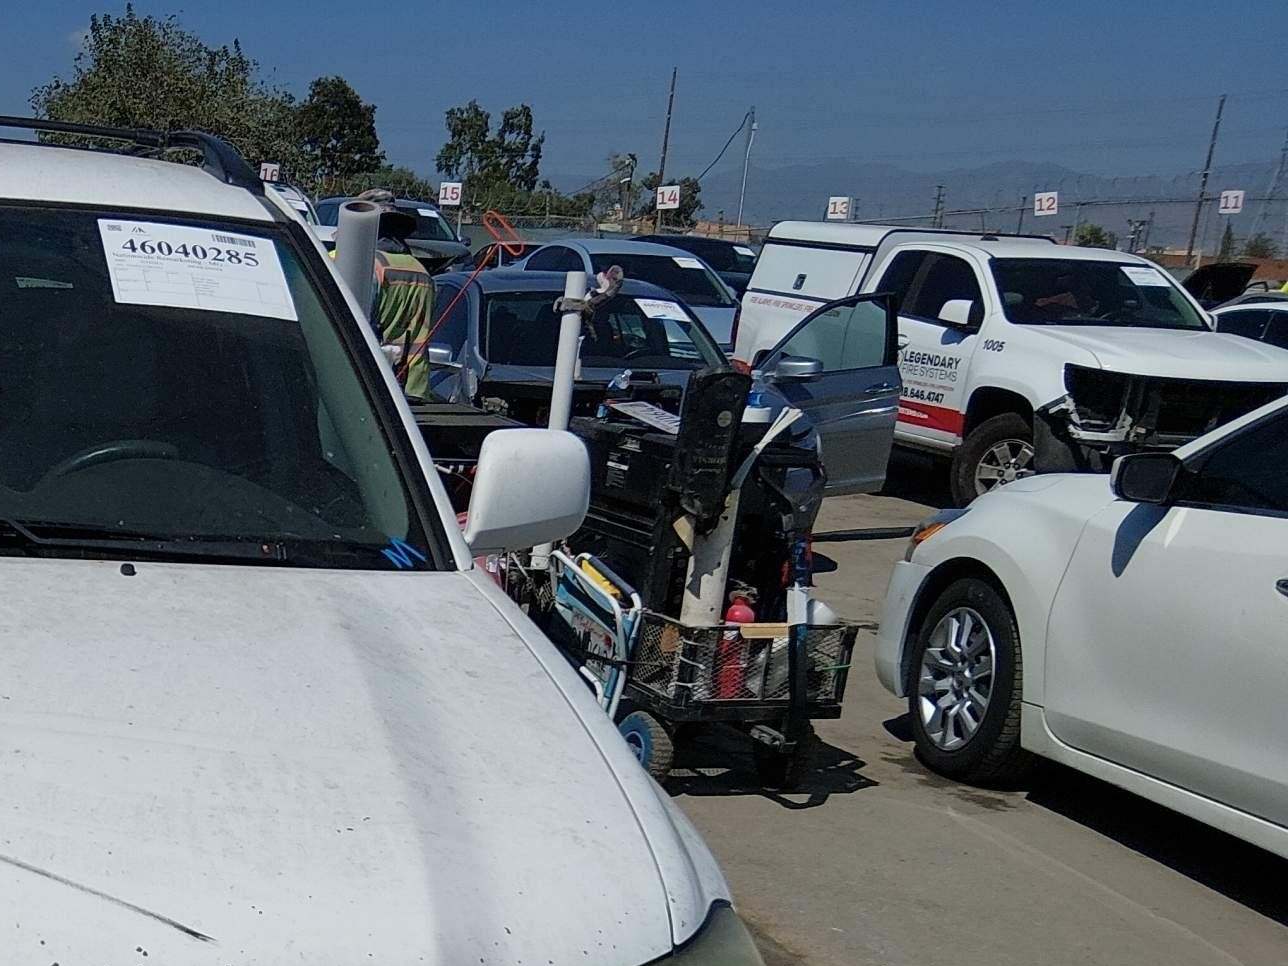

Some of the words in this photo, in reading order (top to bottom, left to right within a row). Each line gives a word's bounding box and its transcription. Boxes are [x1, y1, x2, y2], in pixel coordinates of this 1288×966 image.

[440, 186, 459, 203] 15
[658, 189, 677, 206] 14
[1221, 195, 1240, 210] 11
[830, 201, 848, 216] 13
[1036, 197, 1055, 212] 12
[122, 238, 259, 267] 46040285
[983, 338, 1006, 353] 1005
[903, 350, 962, 371] LEGENDARY
[901, 362, 919, 377] FIRE
[919, 366, 958, 383] SYSTEMS
[901, 386, 945, 404] 8.646.4747
